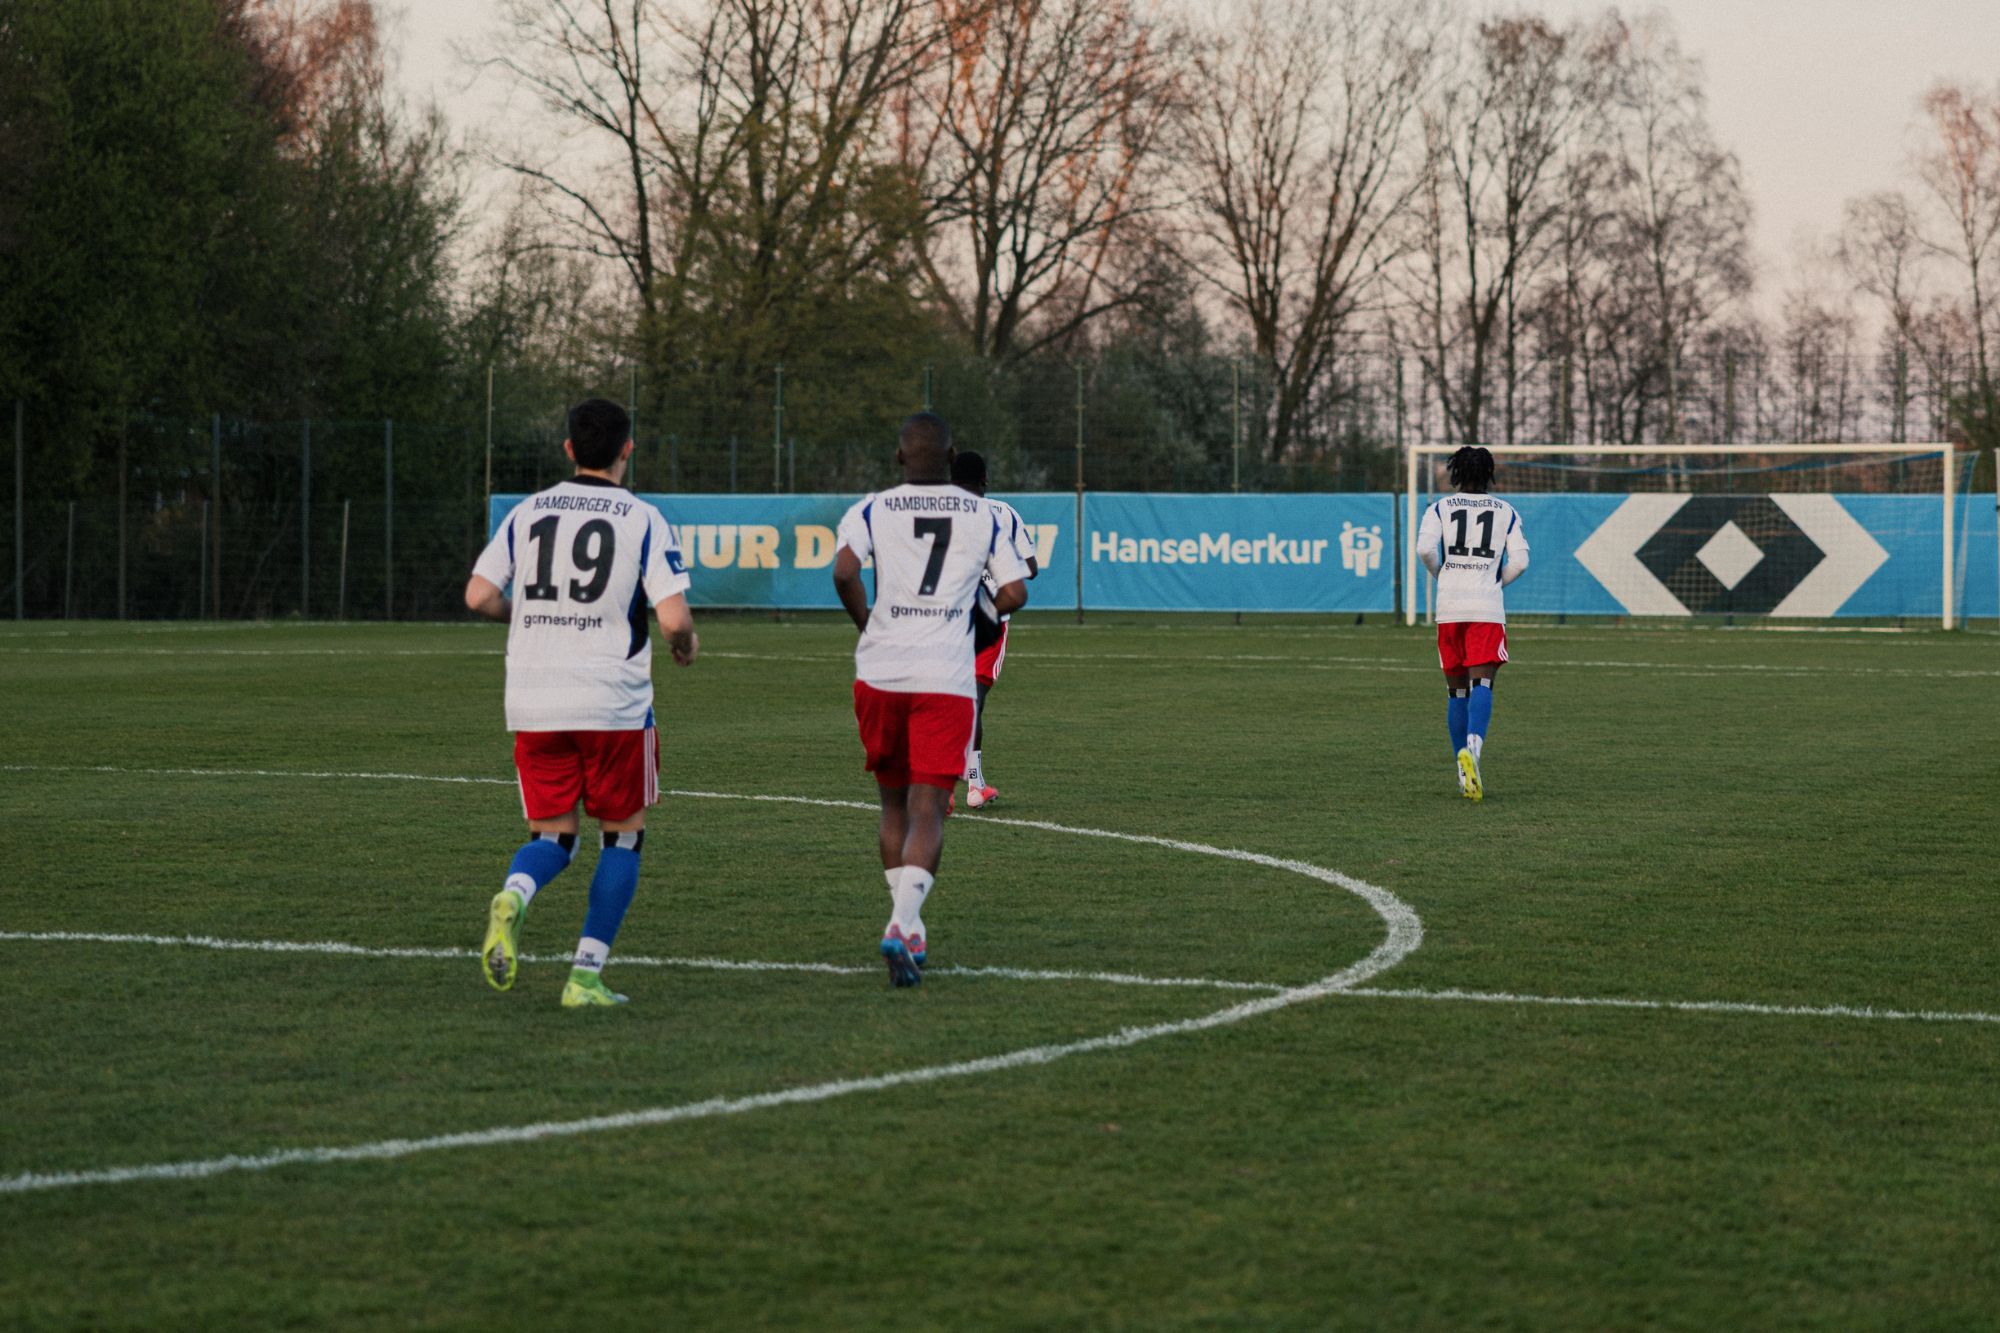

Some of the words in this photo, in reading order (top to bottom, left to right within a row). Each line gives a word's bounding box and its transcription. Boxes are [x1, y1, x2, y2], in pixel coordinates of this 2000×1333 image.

[534, 496, 611, 513] HAMBURGER
[612, 502, 632, 517] SV
[885, 496, 960, 512] HAMBURGER
[963, 499, 977, 513] SV
[1447, 498, 1492, 507] HAMBURGER
[1494, 501, 1502, 509] SV
[1448, 509, 1495, 558] 11
[525, 515, 615, 604] 19
[914, 517, 952, 595] 7
[1091, 531, 1328, 564] HanseMerkur
[524, 613, 602, 631] gamesright
